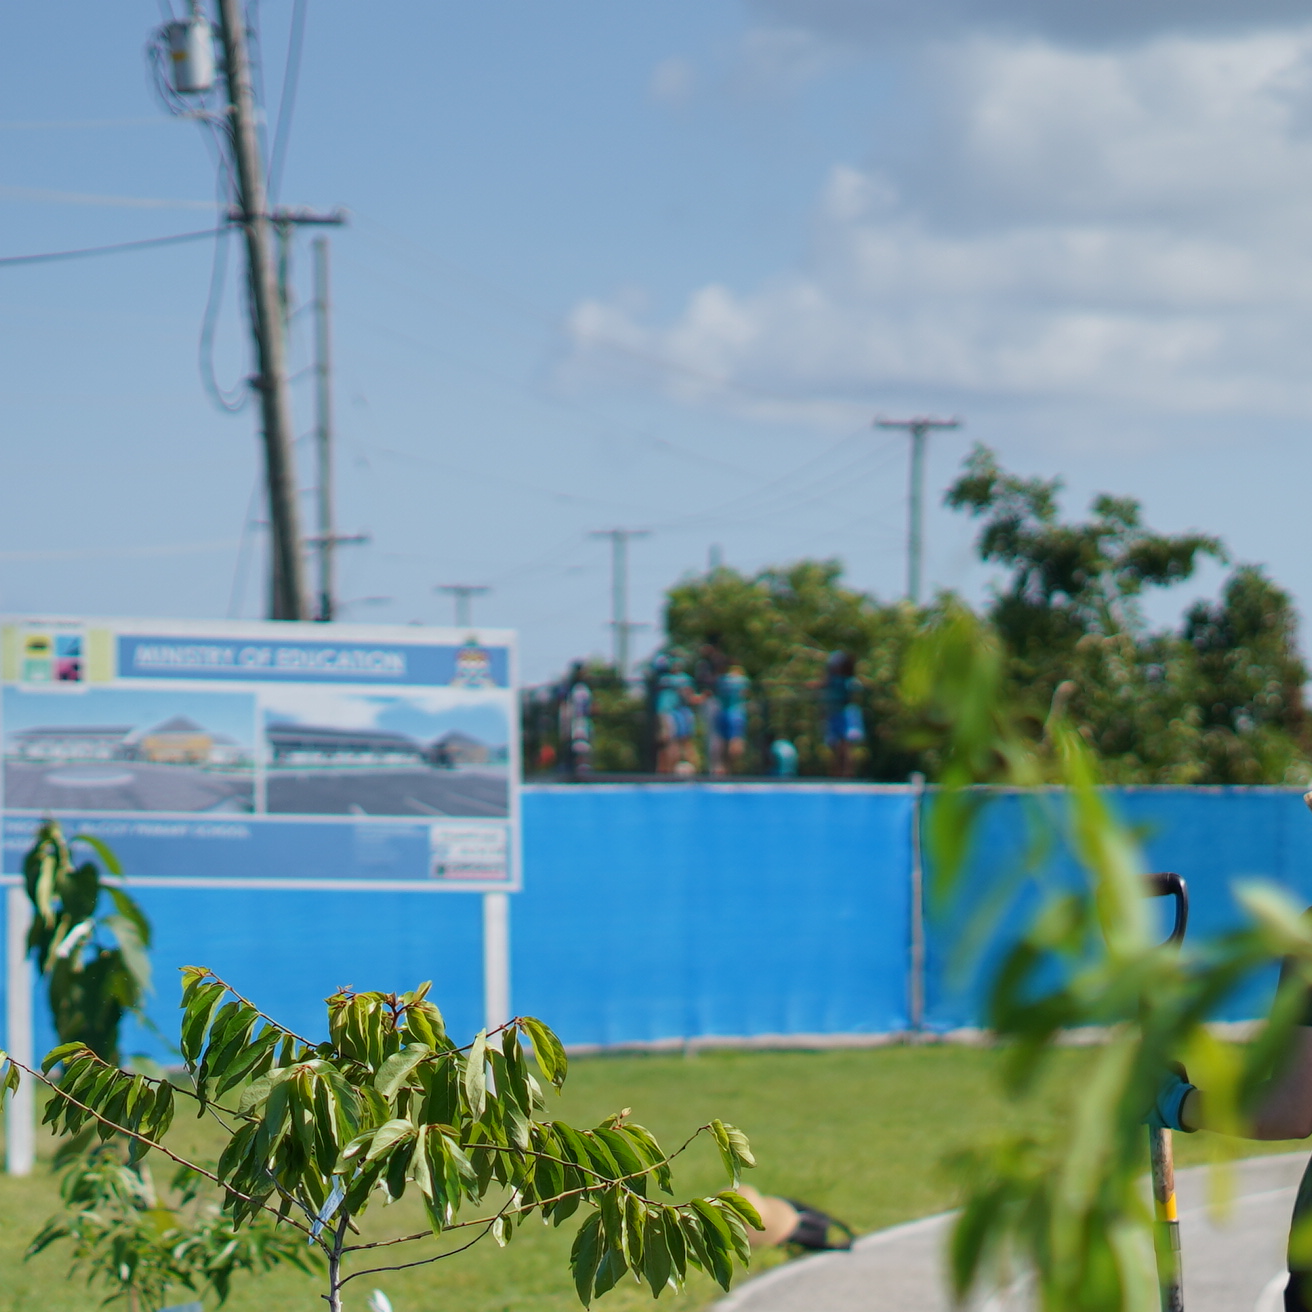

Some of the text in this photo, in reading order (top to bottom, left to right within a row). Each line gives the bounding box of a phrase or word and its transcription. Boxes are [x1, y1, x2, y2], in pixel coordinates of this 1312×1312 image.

[134, 644, 407, 670] MINISTRY OF EDUCATION
